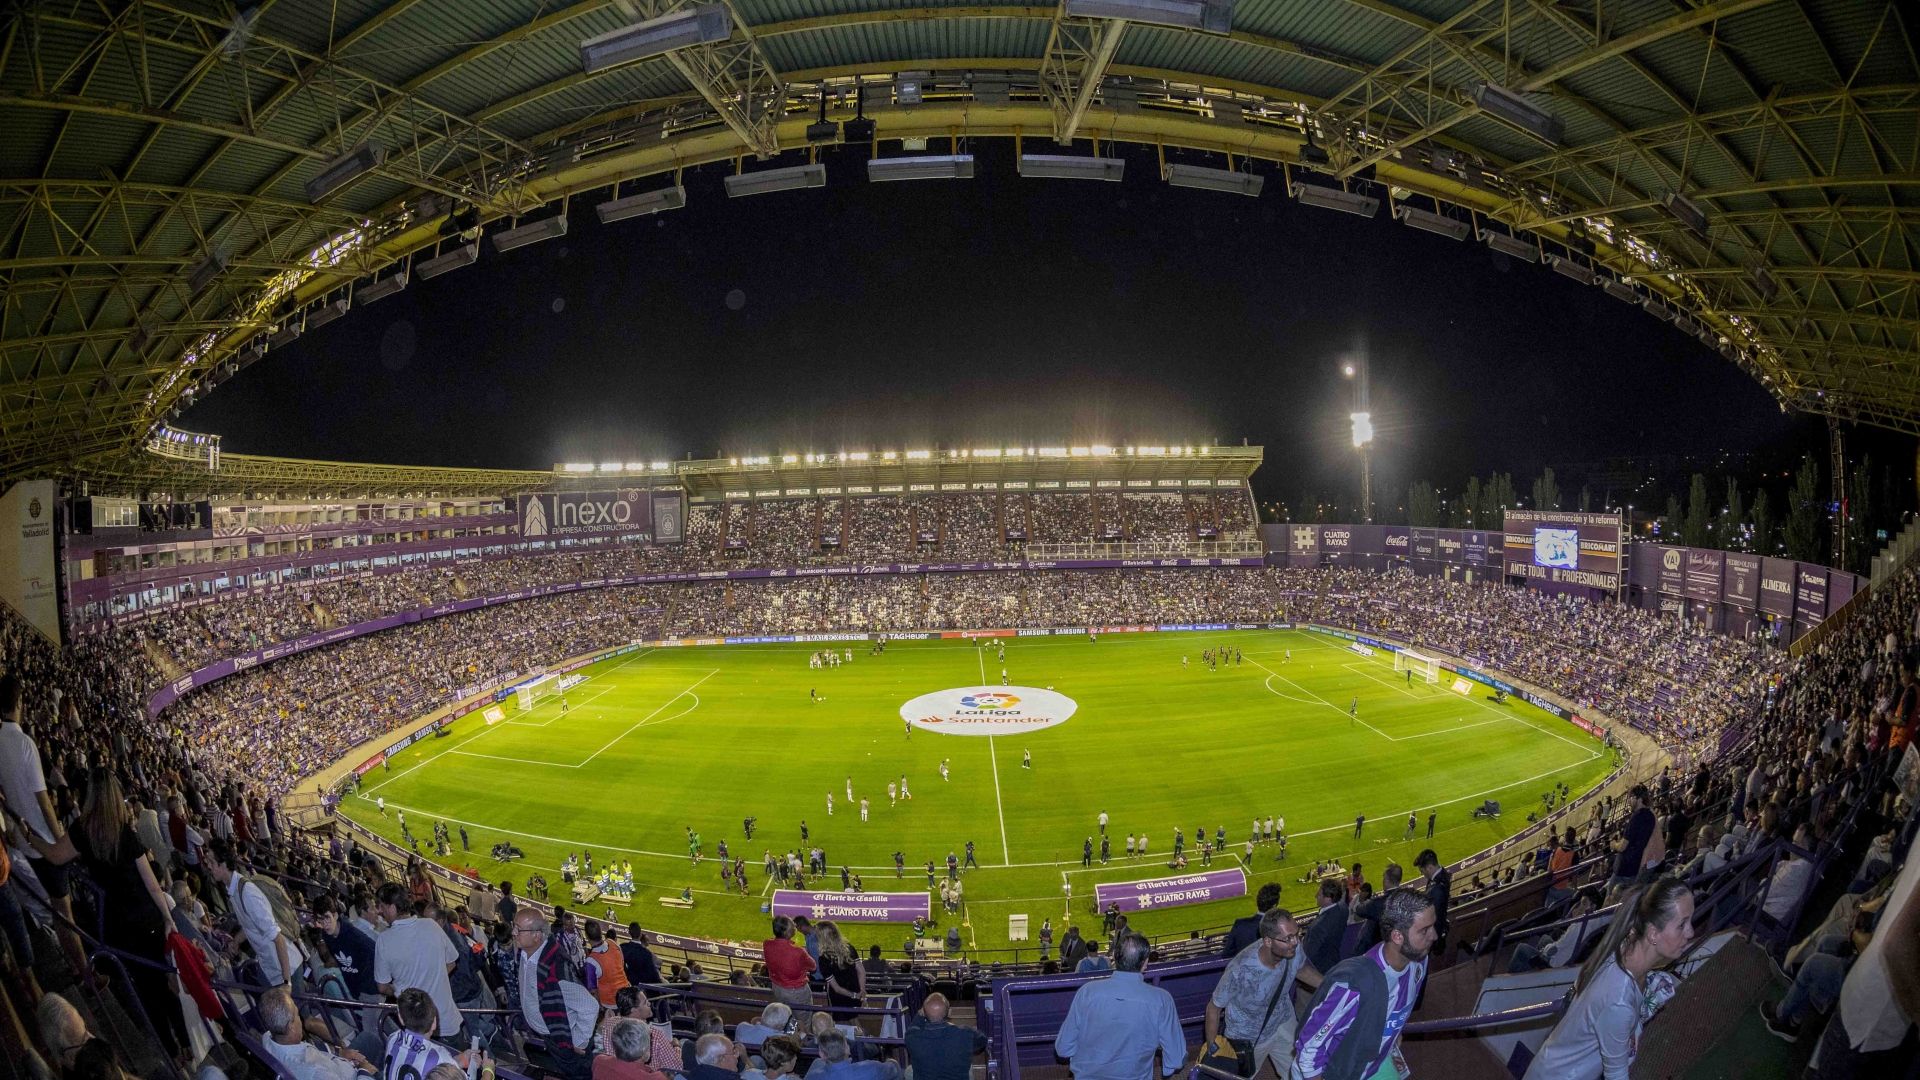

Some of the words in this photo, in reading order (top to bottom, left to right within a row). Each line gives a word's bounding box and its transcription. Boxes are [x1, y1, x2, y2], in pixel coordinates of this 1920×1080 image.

[553, 495, 631, 527] Inexo
[1533, 512, 1540, 520] de
[1541, 512, 1547, 520] la
[1588, 515, 1594, 523] la
[1595, 515, 1619, 525] reforma
[552, 526, 582, 535] EMPRESA
[583, 523, 640, 533] CONSTRUCTORA
[1324, 531, 1350, 539] CUATRO
[1326, 538, 1348, 546] RAYAS
[1580, 541, 1616, 553] BRICOMART
[1509, 562, 1526, 576] ANTE
[1561, 569, 1618, 589] PROFESIONALES
[1761, 578, 1791, 594] ALIMERKA
[385, 736, 412, 758] SAMSUNG
[415, 721, 440, 740] SAMSUG
[1148, 881, 1168, 889] Norte
[1177, 876, 1208, 885] Castilla
[1154, 892, 1184, 904] CUATRO
[1185, 889, 1211, 900] RAYAS
[828, 908, 860, 917] CUATRO
[861, 909, 888, 917] RAYAS
